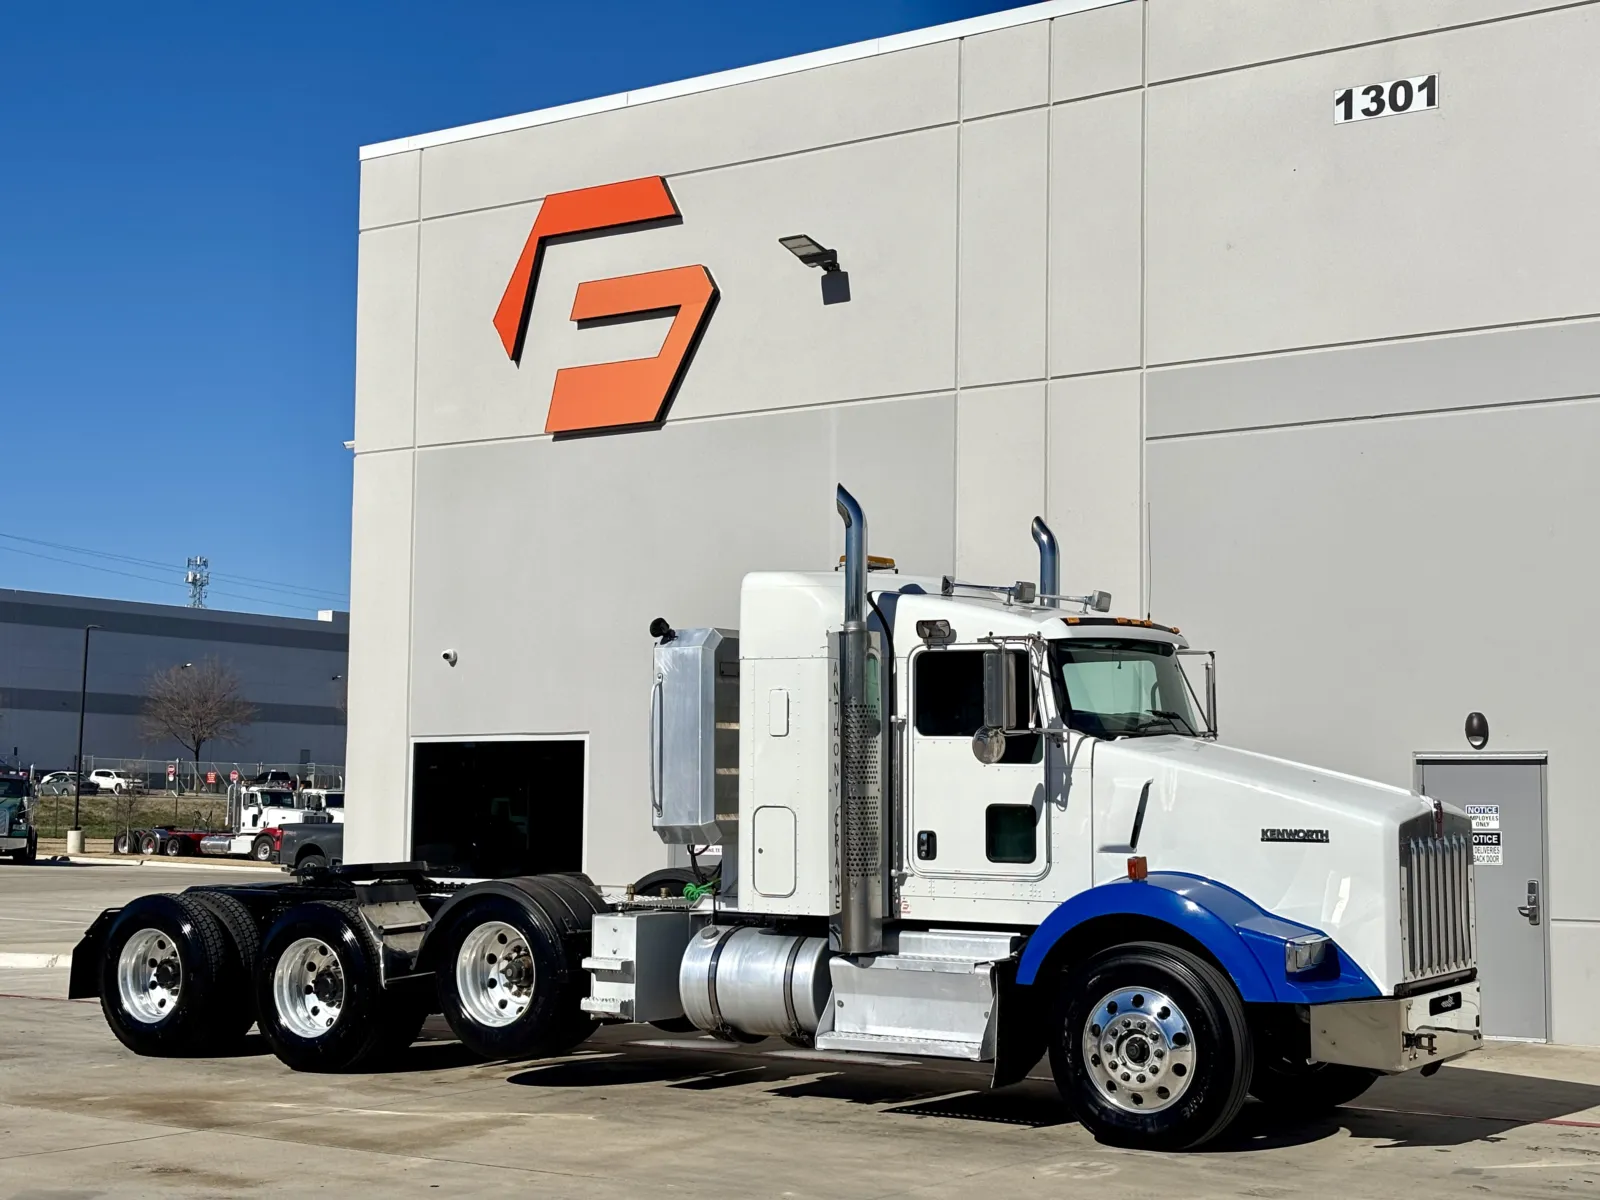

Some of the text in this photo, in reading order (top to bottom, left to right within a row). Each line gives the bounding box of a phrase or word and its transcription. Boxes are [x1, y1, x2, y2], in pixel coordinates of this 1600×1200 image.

[1335, 75, 1436, 120] 1301
[1468, 806, 1498, 814] NOTICE
[1261, 828, 1329, 841] KENWORTH
[1473, 835, 1498, 843] OTICE
[1474, 846, 1500, 854] DELIVERIES
